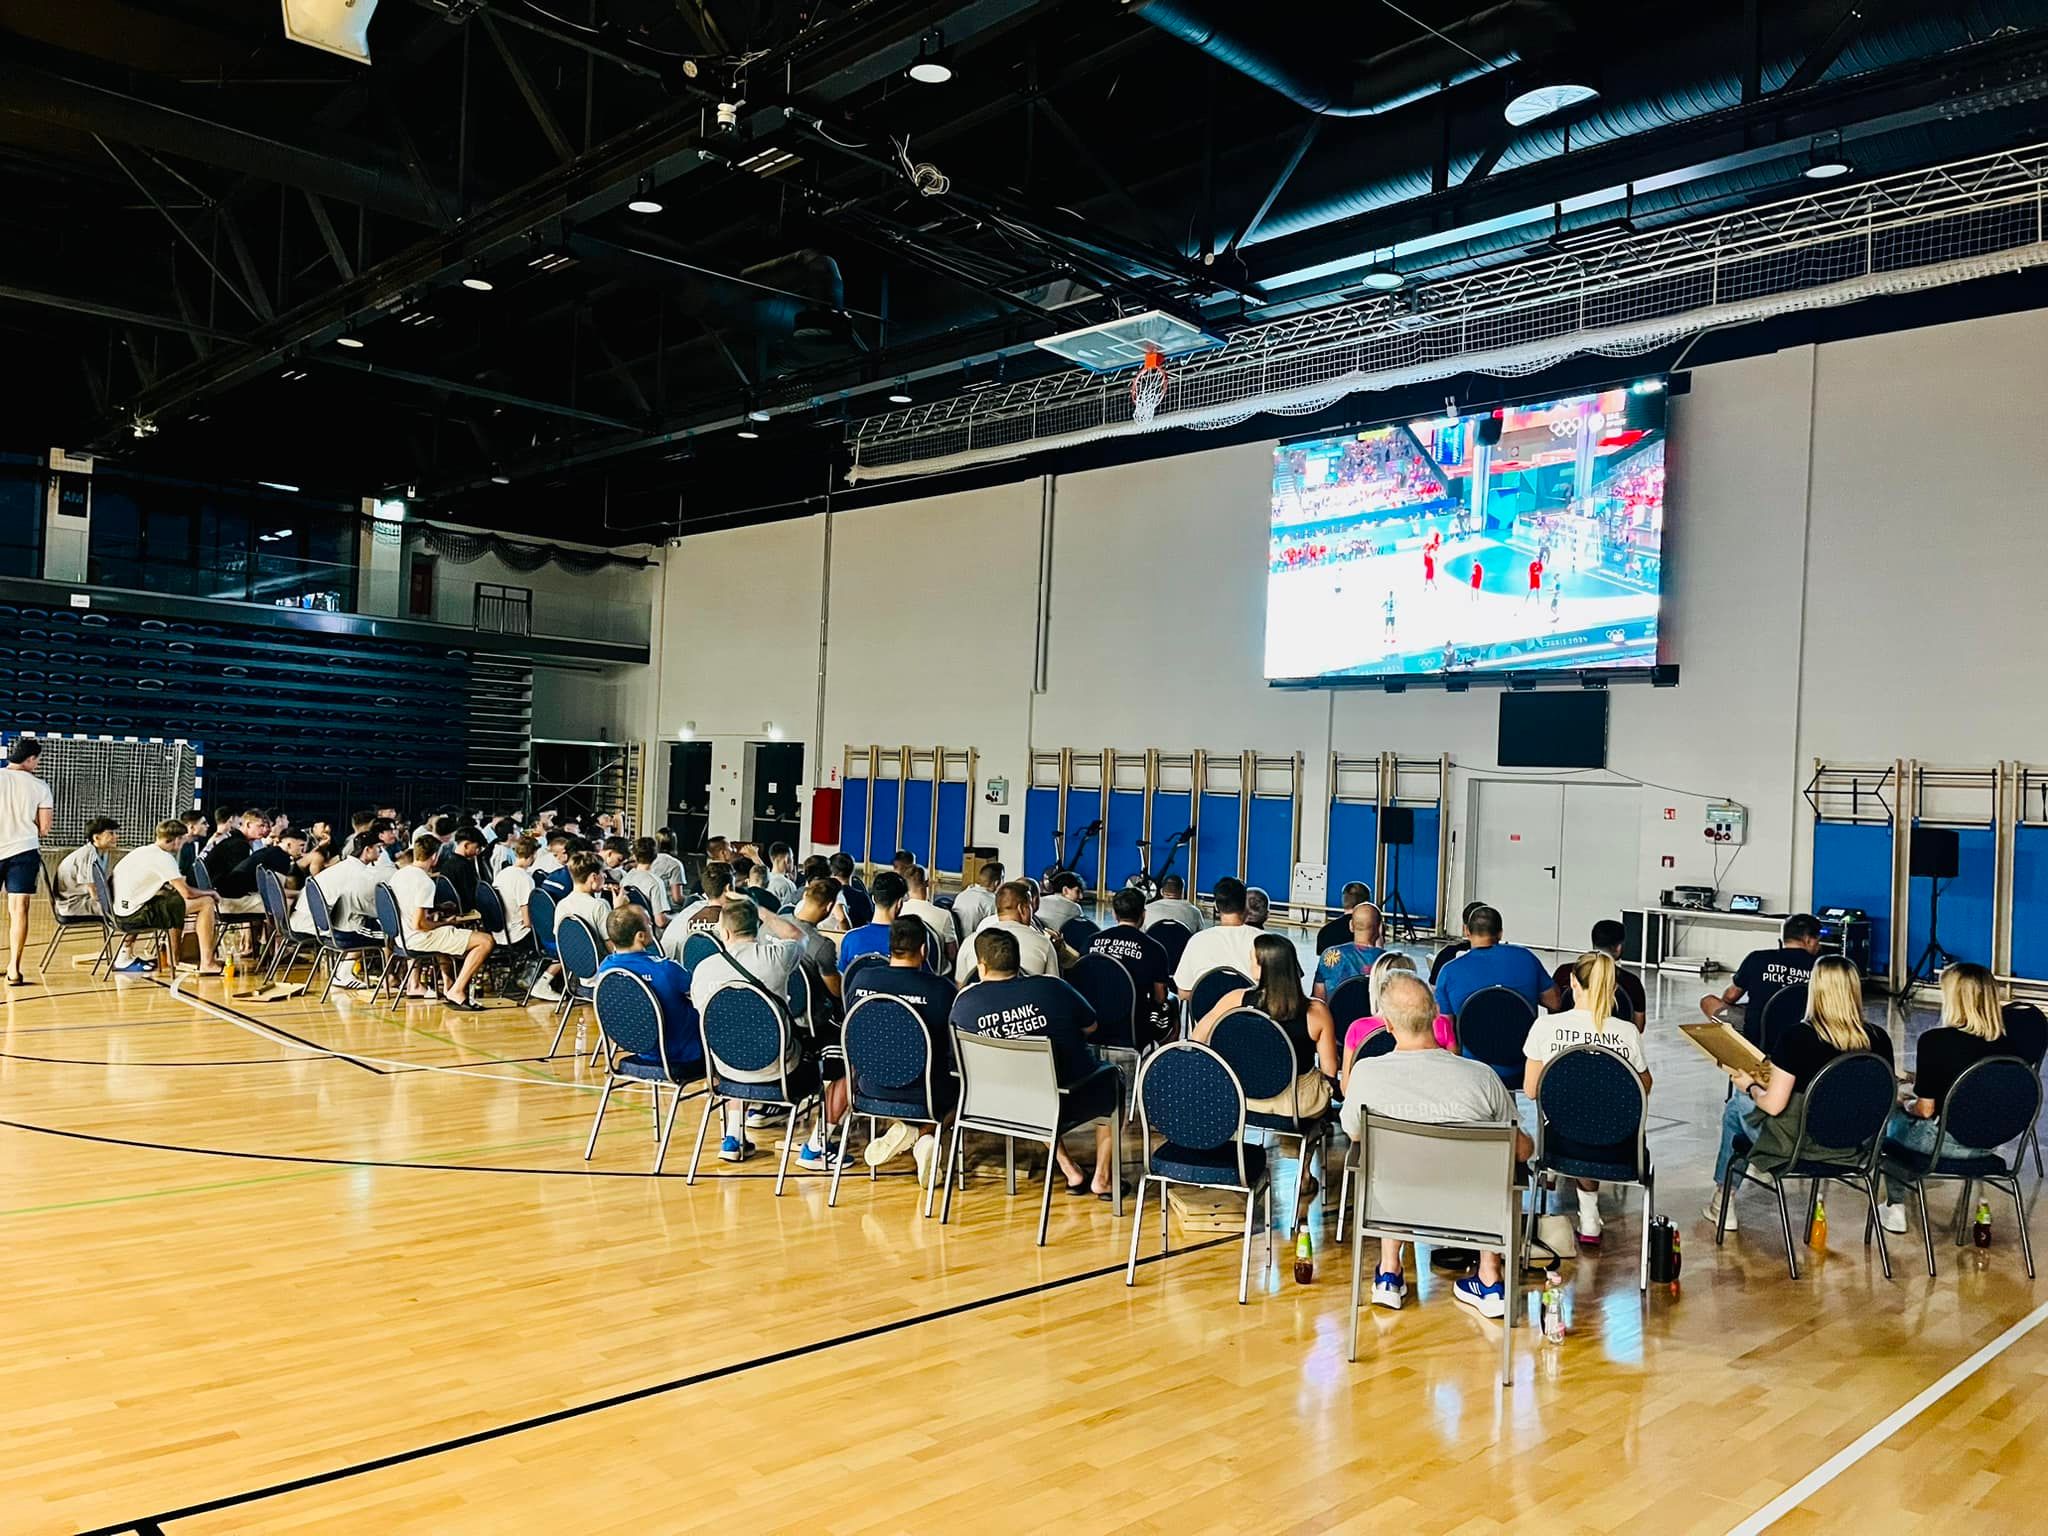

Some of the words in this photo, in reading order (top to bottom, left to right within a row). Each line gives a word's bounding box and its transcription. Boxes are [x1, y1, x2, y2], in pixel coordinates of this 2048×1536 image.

[1094, 938, 1111, 947] OTP
[1107, 946, 1142, 960] SZEGED
[1762, 972, 1785, 983] PICK
[1767, 963, 1787, 974] OTP
[1789, 967, 1810, 979] BAN
[977, 1012, 1000, 1029] OTP
[1002, 1003, 1039, 1023] BANK-
[1002, 1015, 1047, 1036] SZEGED
[1555, 1028, 1580, 1042] OTP
[1584, 1032, 1624, 1045] BANK-
[1550, 1043, 1569, 1053] PIC
